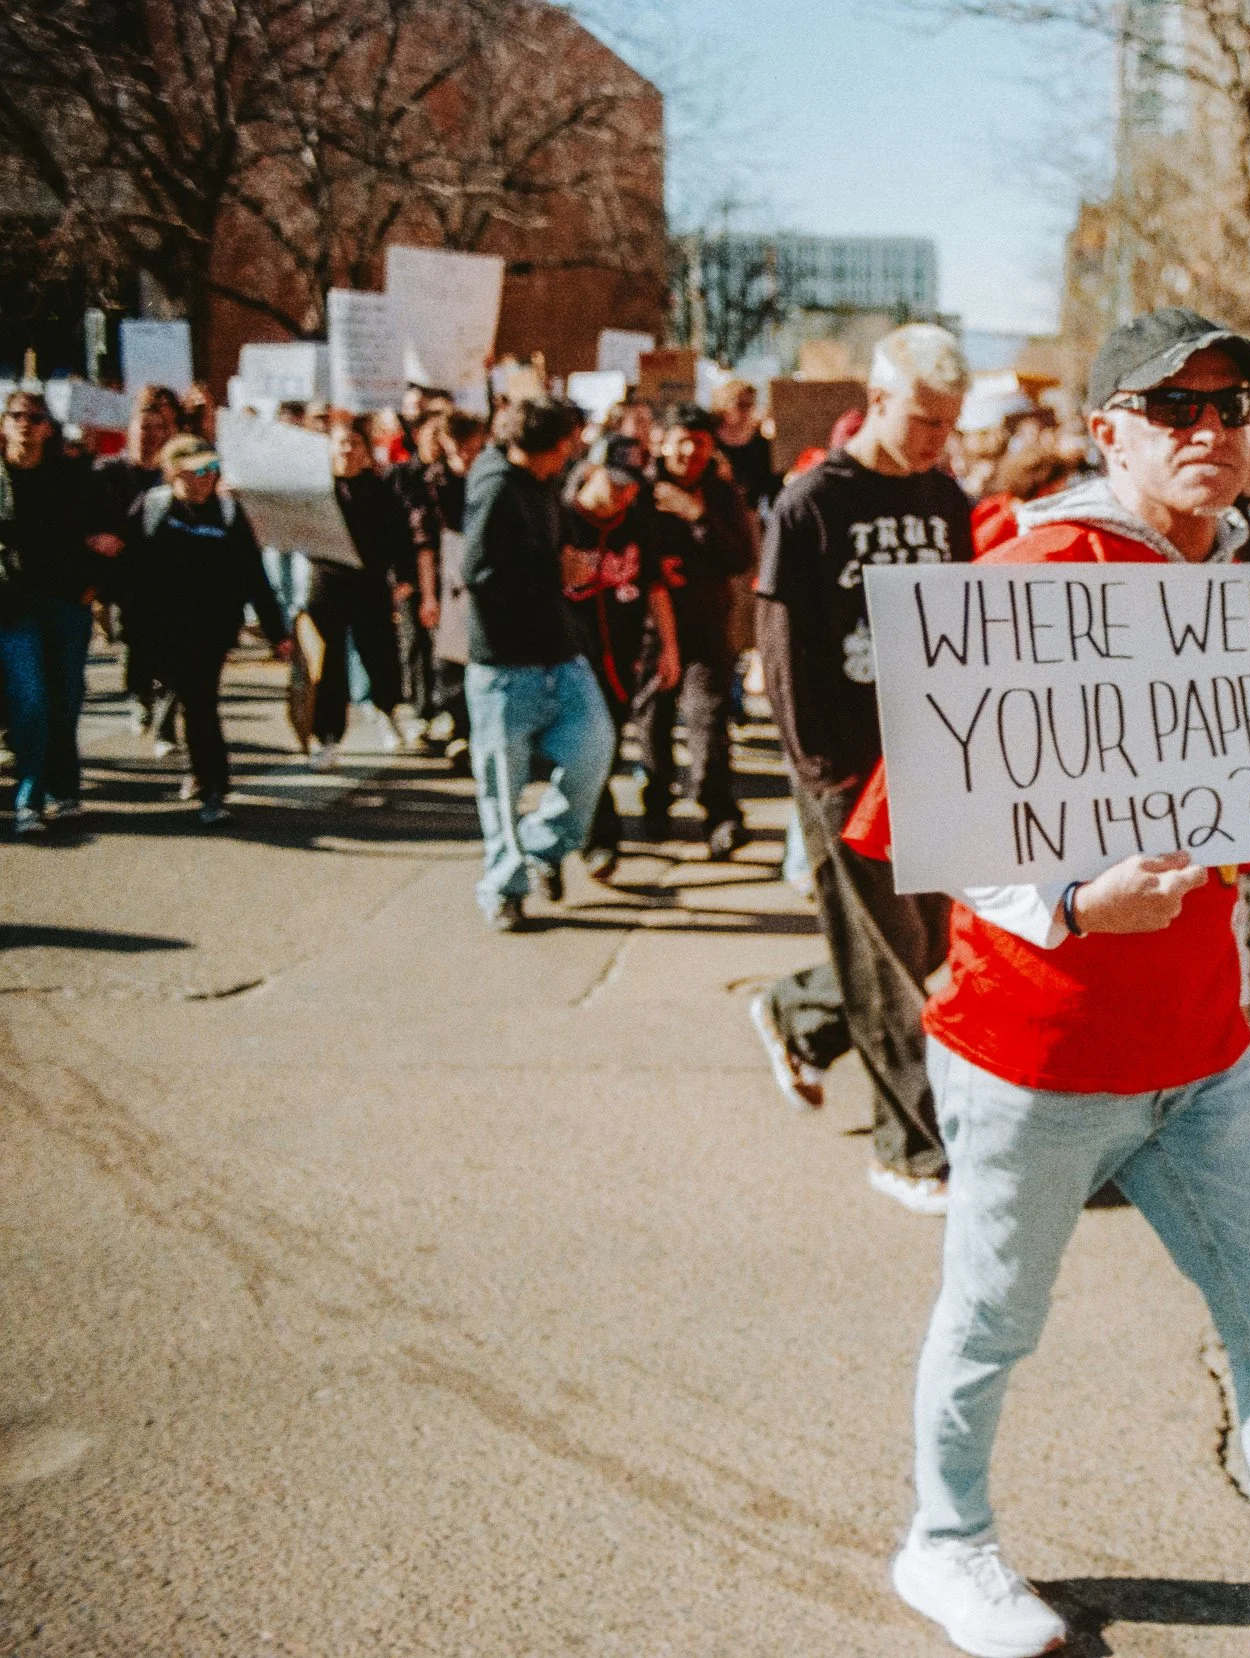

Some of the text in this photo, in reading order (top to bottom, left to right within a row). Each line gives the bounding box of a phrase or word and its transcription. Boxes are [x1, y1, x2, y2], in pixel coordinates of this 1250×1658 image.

[914, 580, 1133, 668] WHERE
[925, 682, 1138, 793] YOUR
[1013, 800, 1066, 866] IN
